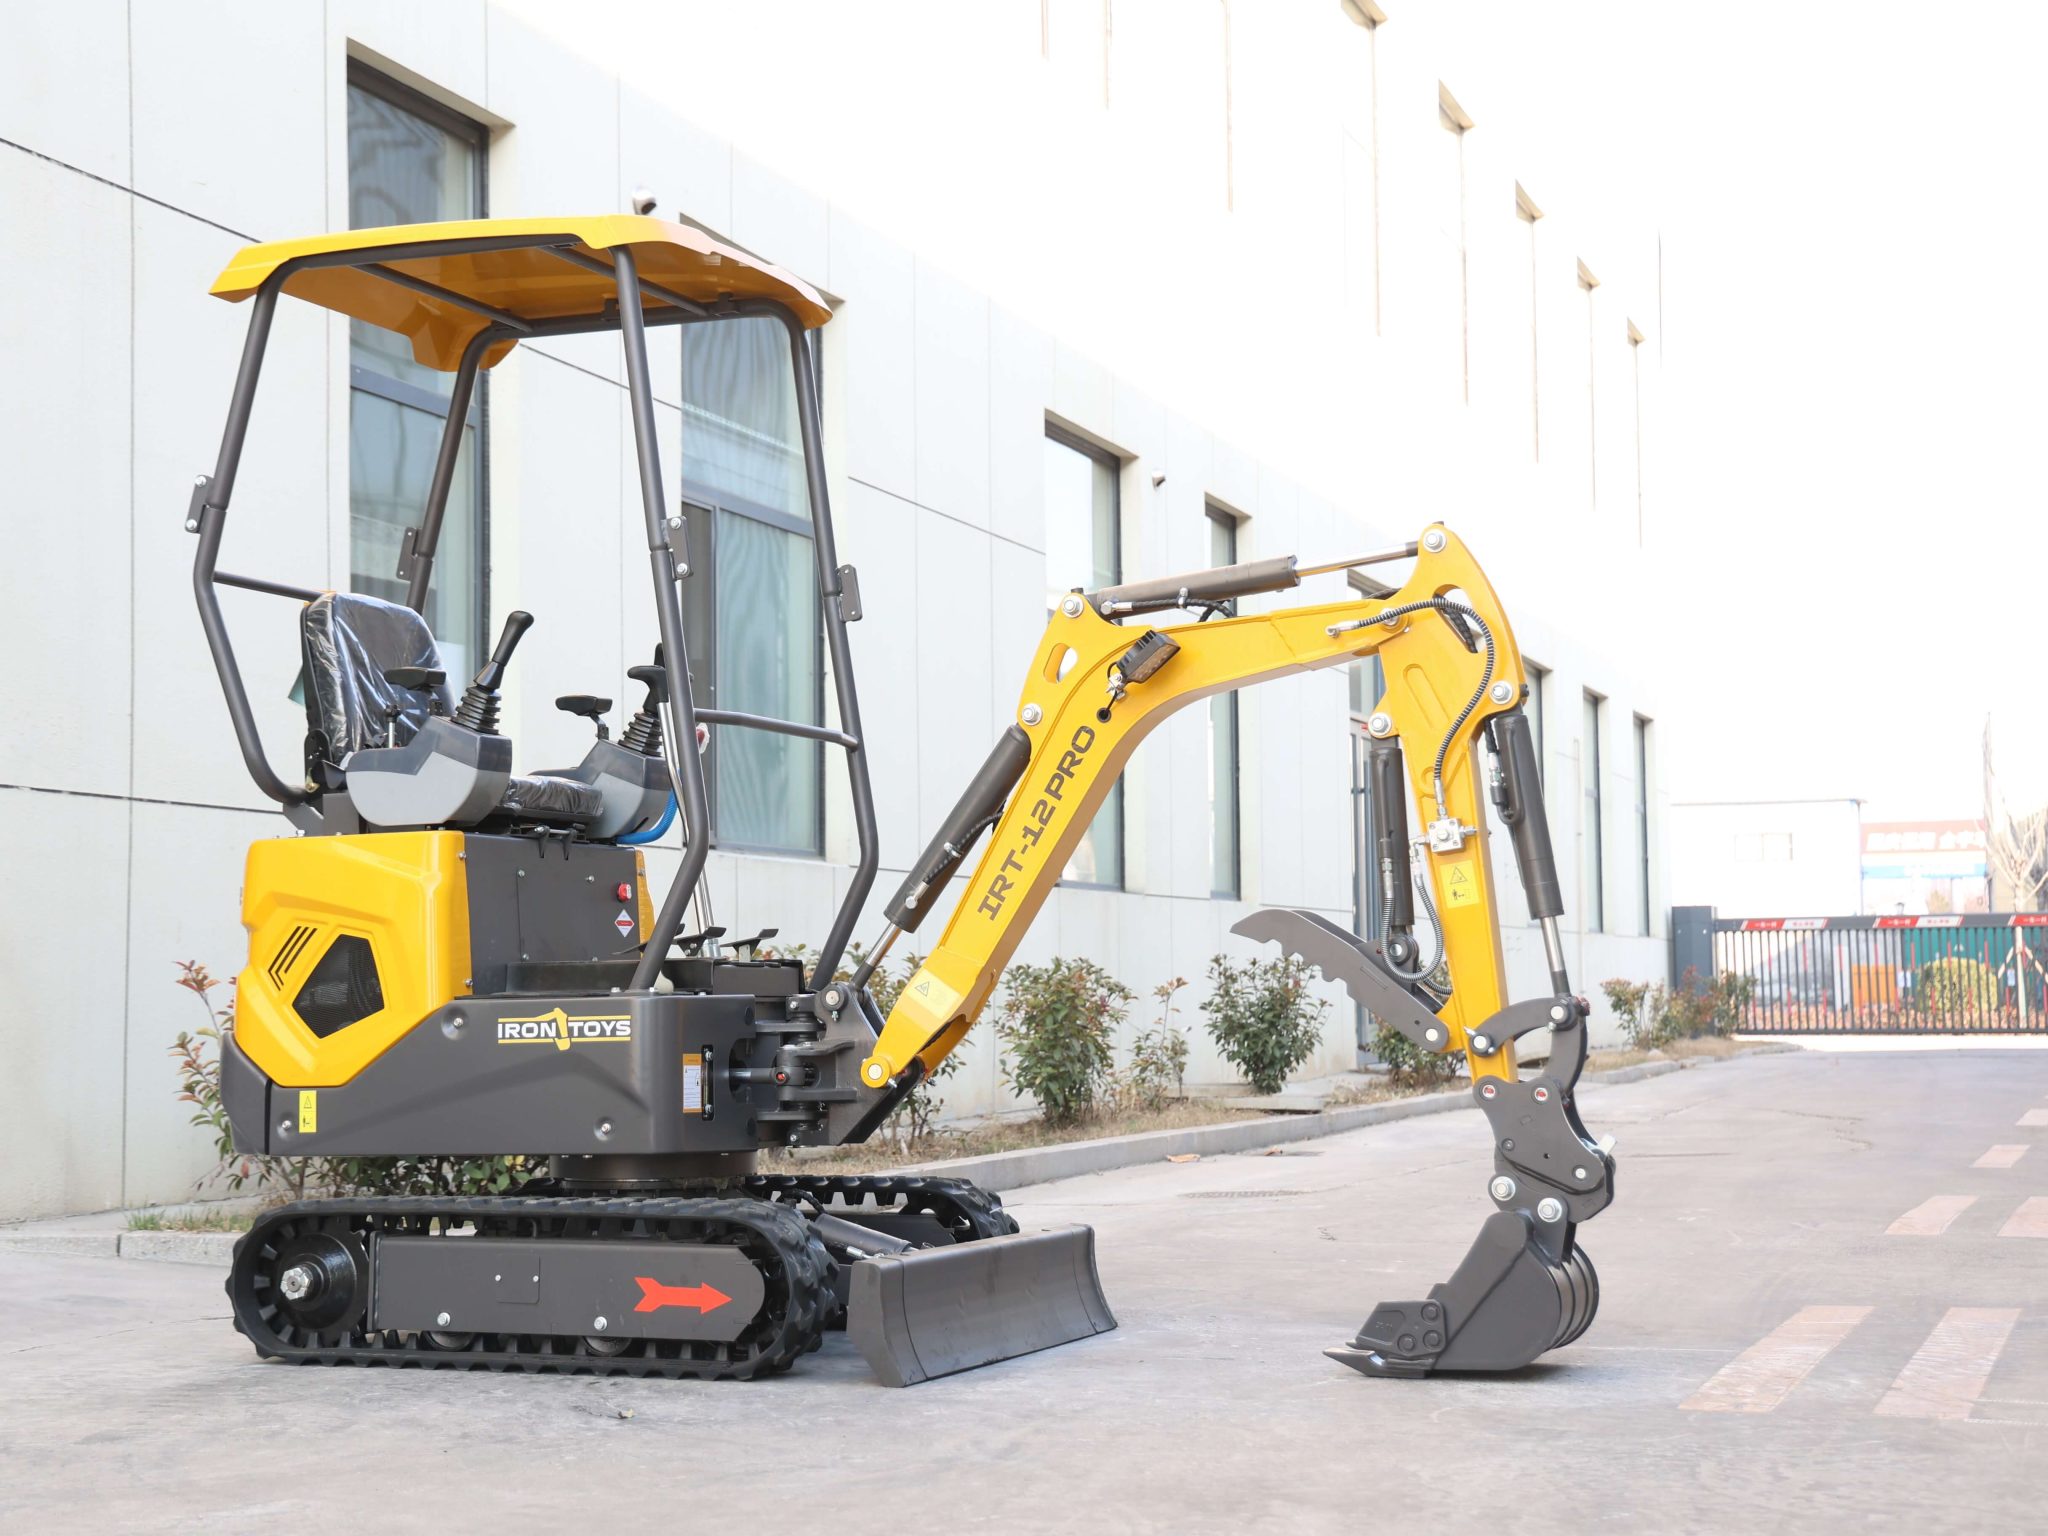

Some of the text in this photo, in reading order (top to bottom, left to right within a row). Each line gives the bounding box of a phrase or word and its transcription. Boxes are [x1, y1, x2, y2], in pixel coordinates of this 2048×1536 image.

[978, 725, 1096, 921] IRT-12 PRO
[498, 1020, 631, 1038] IRON TOYS
